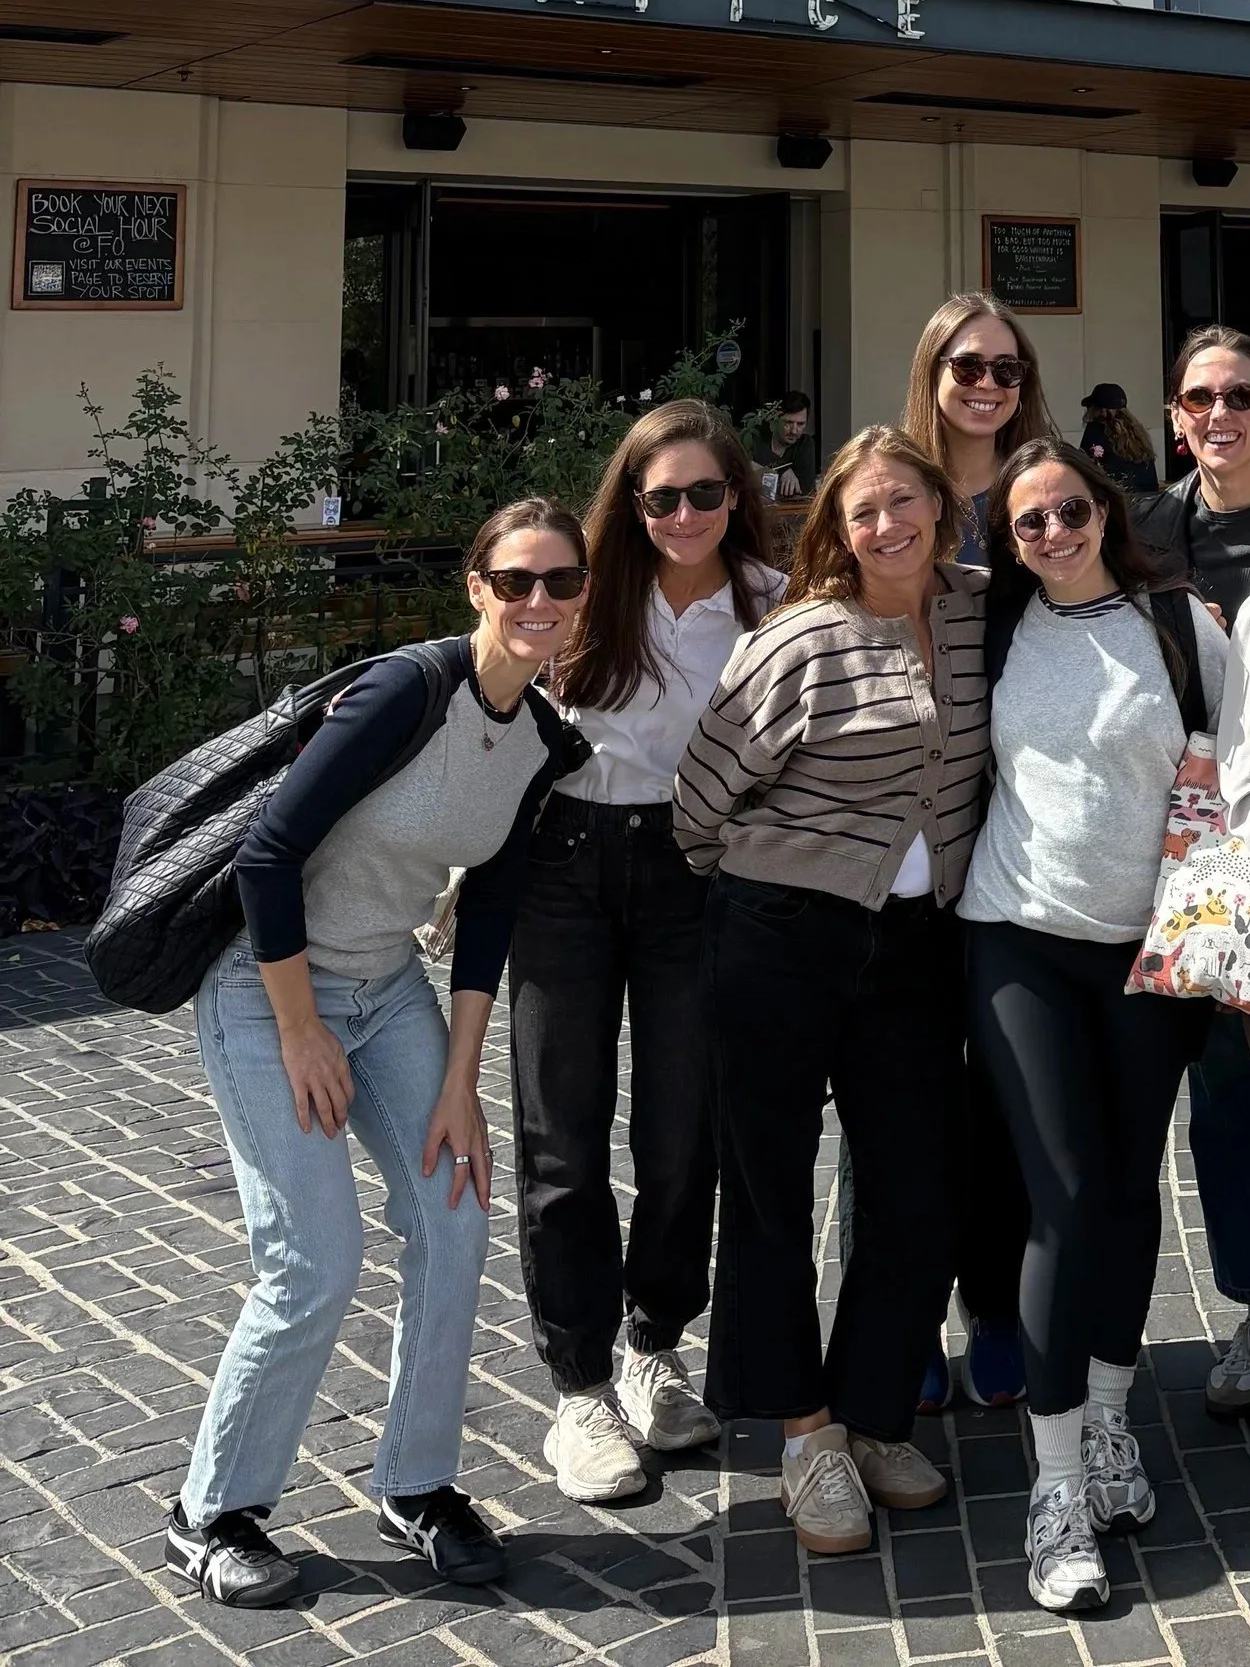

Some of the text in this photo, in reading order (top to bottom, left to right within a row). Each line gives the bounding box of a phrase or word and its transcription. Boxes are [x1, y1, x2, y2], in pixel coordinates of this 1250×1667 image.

[32, 193, 176, 217] BOOK YOUR NEXT
[29, 214, 174, 240] SOCIAL HOUR
[73, 237, 94, 254] @
[69, 259, 173, 270] VISIT OUR EVENTS
[72, 272, 174, 285] PAGE TO RESERVE
[72, 285, 124, 298] YOUR
